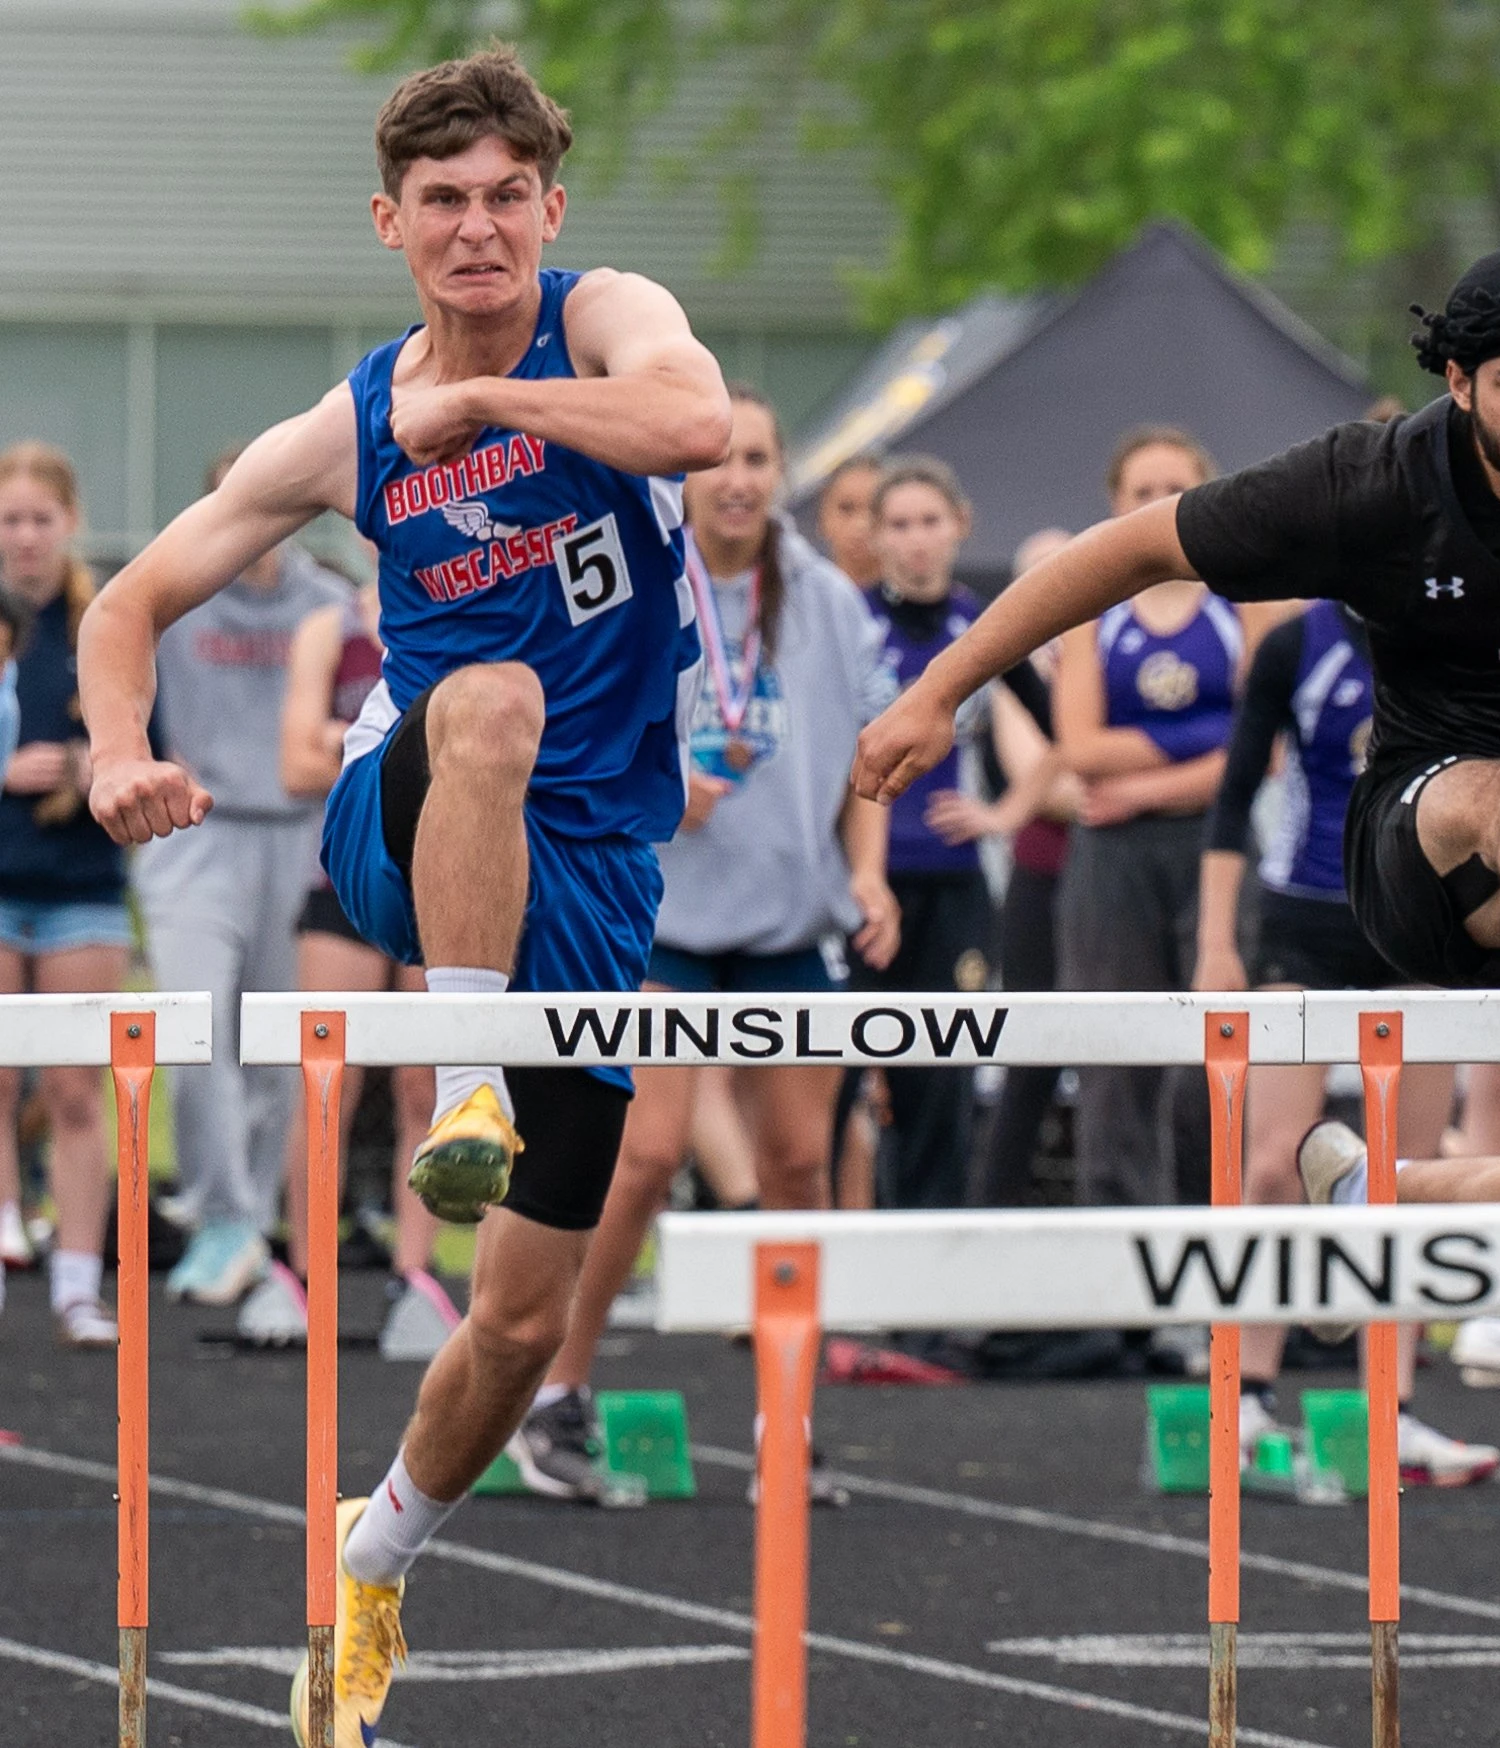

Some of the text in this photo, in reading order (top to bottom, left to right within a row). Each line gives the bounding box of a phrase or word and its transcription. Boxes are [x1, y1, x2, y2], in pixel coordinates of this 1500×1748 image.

[384, 432, 546, 526] BOOTHBAY
[564, 526, 617, 611] 5
[544, 1007, 1009, 1058] WINSLOW
